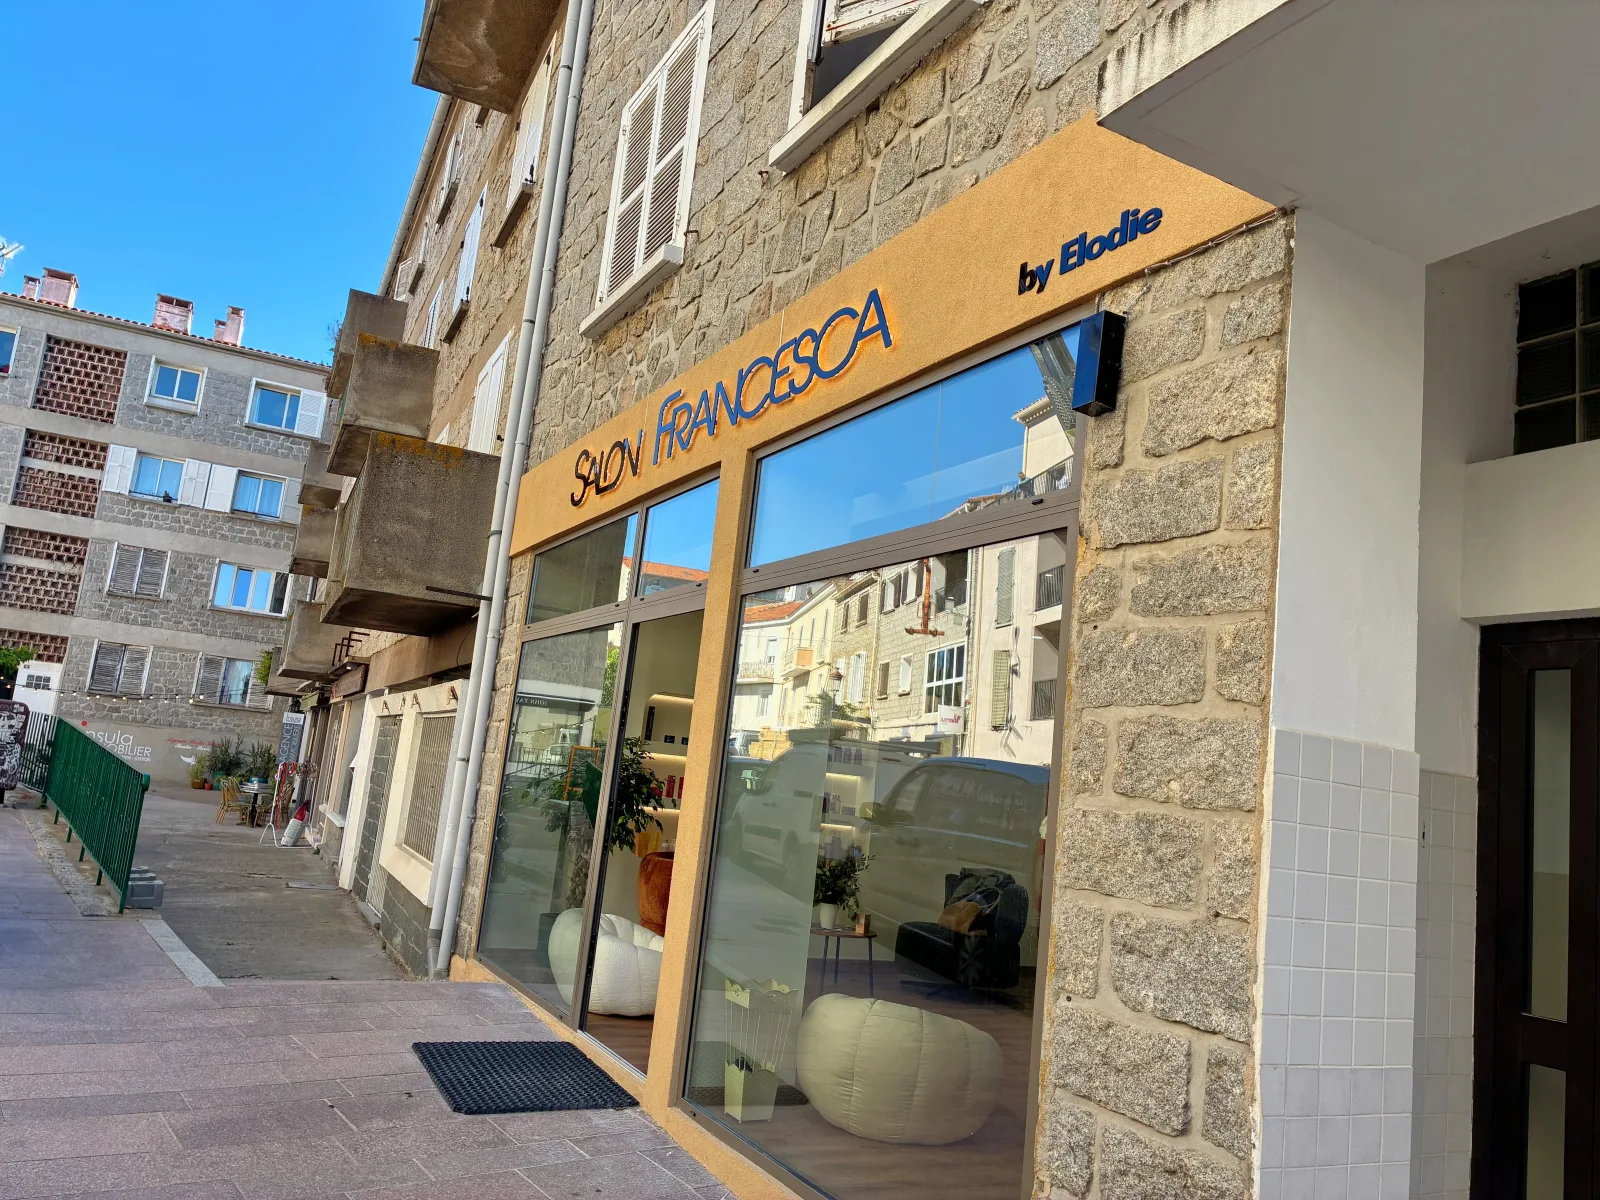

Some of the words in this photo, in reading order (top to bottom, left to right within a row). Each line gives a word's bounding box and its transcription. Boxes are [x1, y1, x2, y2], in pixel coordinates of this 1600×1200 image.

[1018, 258, 1055, 296] by
[1059, 207, 1163, 275] Elodie
[652, 288, 893, 466] FRANCESCA
[279, 724, 293, 762] AGENCE
